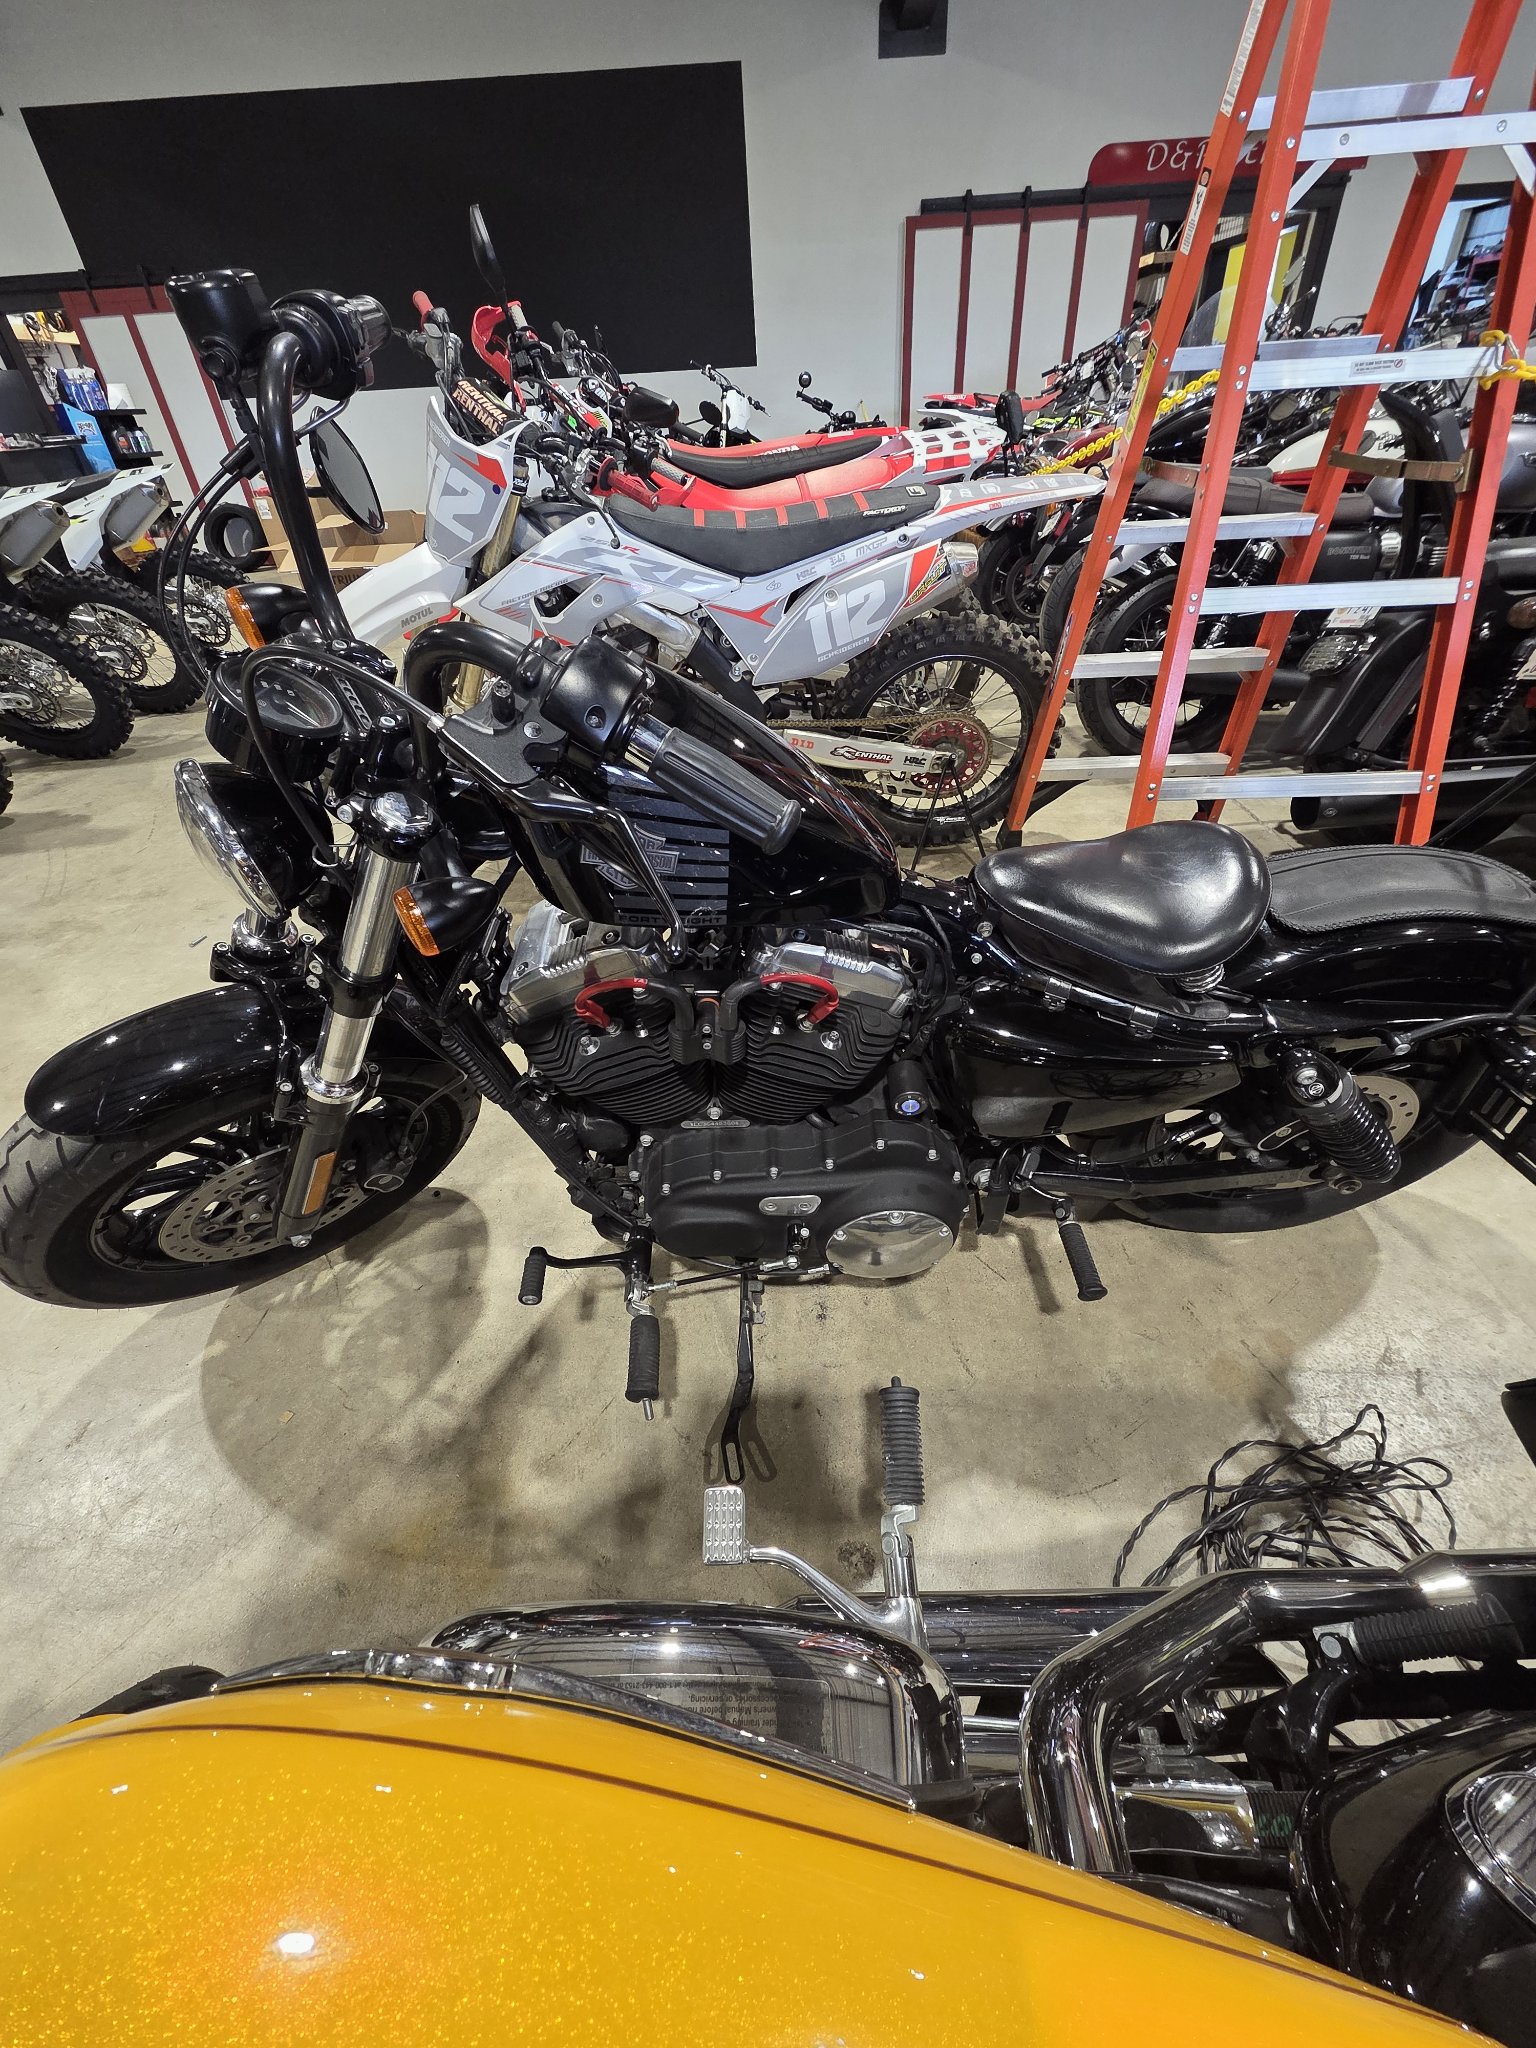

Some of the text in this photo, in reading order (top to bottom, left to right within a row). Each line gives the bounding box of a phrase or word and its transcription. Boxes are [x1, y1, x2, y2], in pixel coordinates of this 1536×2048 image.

[451, 387, 500, 436] RENTHAL
[457, 380, 508, 424] RENTHAL
[501, 577, 570, 607] FACTORY RACING
[401, 607, 434, 628] MOTUL
[805, 580, 888, 655] 112
[817, 637, 871, 663] SCHEIDERER
[790, 737, 815, 749] DID
[903, 755, 928, 766] HRC
[688, 1693, 723, 1703] servicing.
[699, 1706, 722, 1715] before
[725, 1706, 752, 1715] Manual
